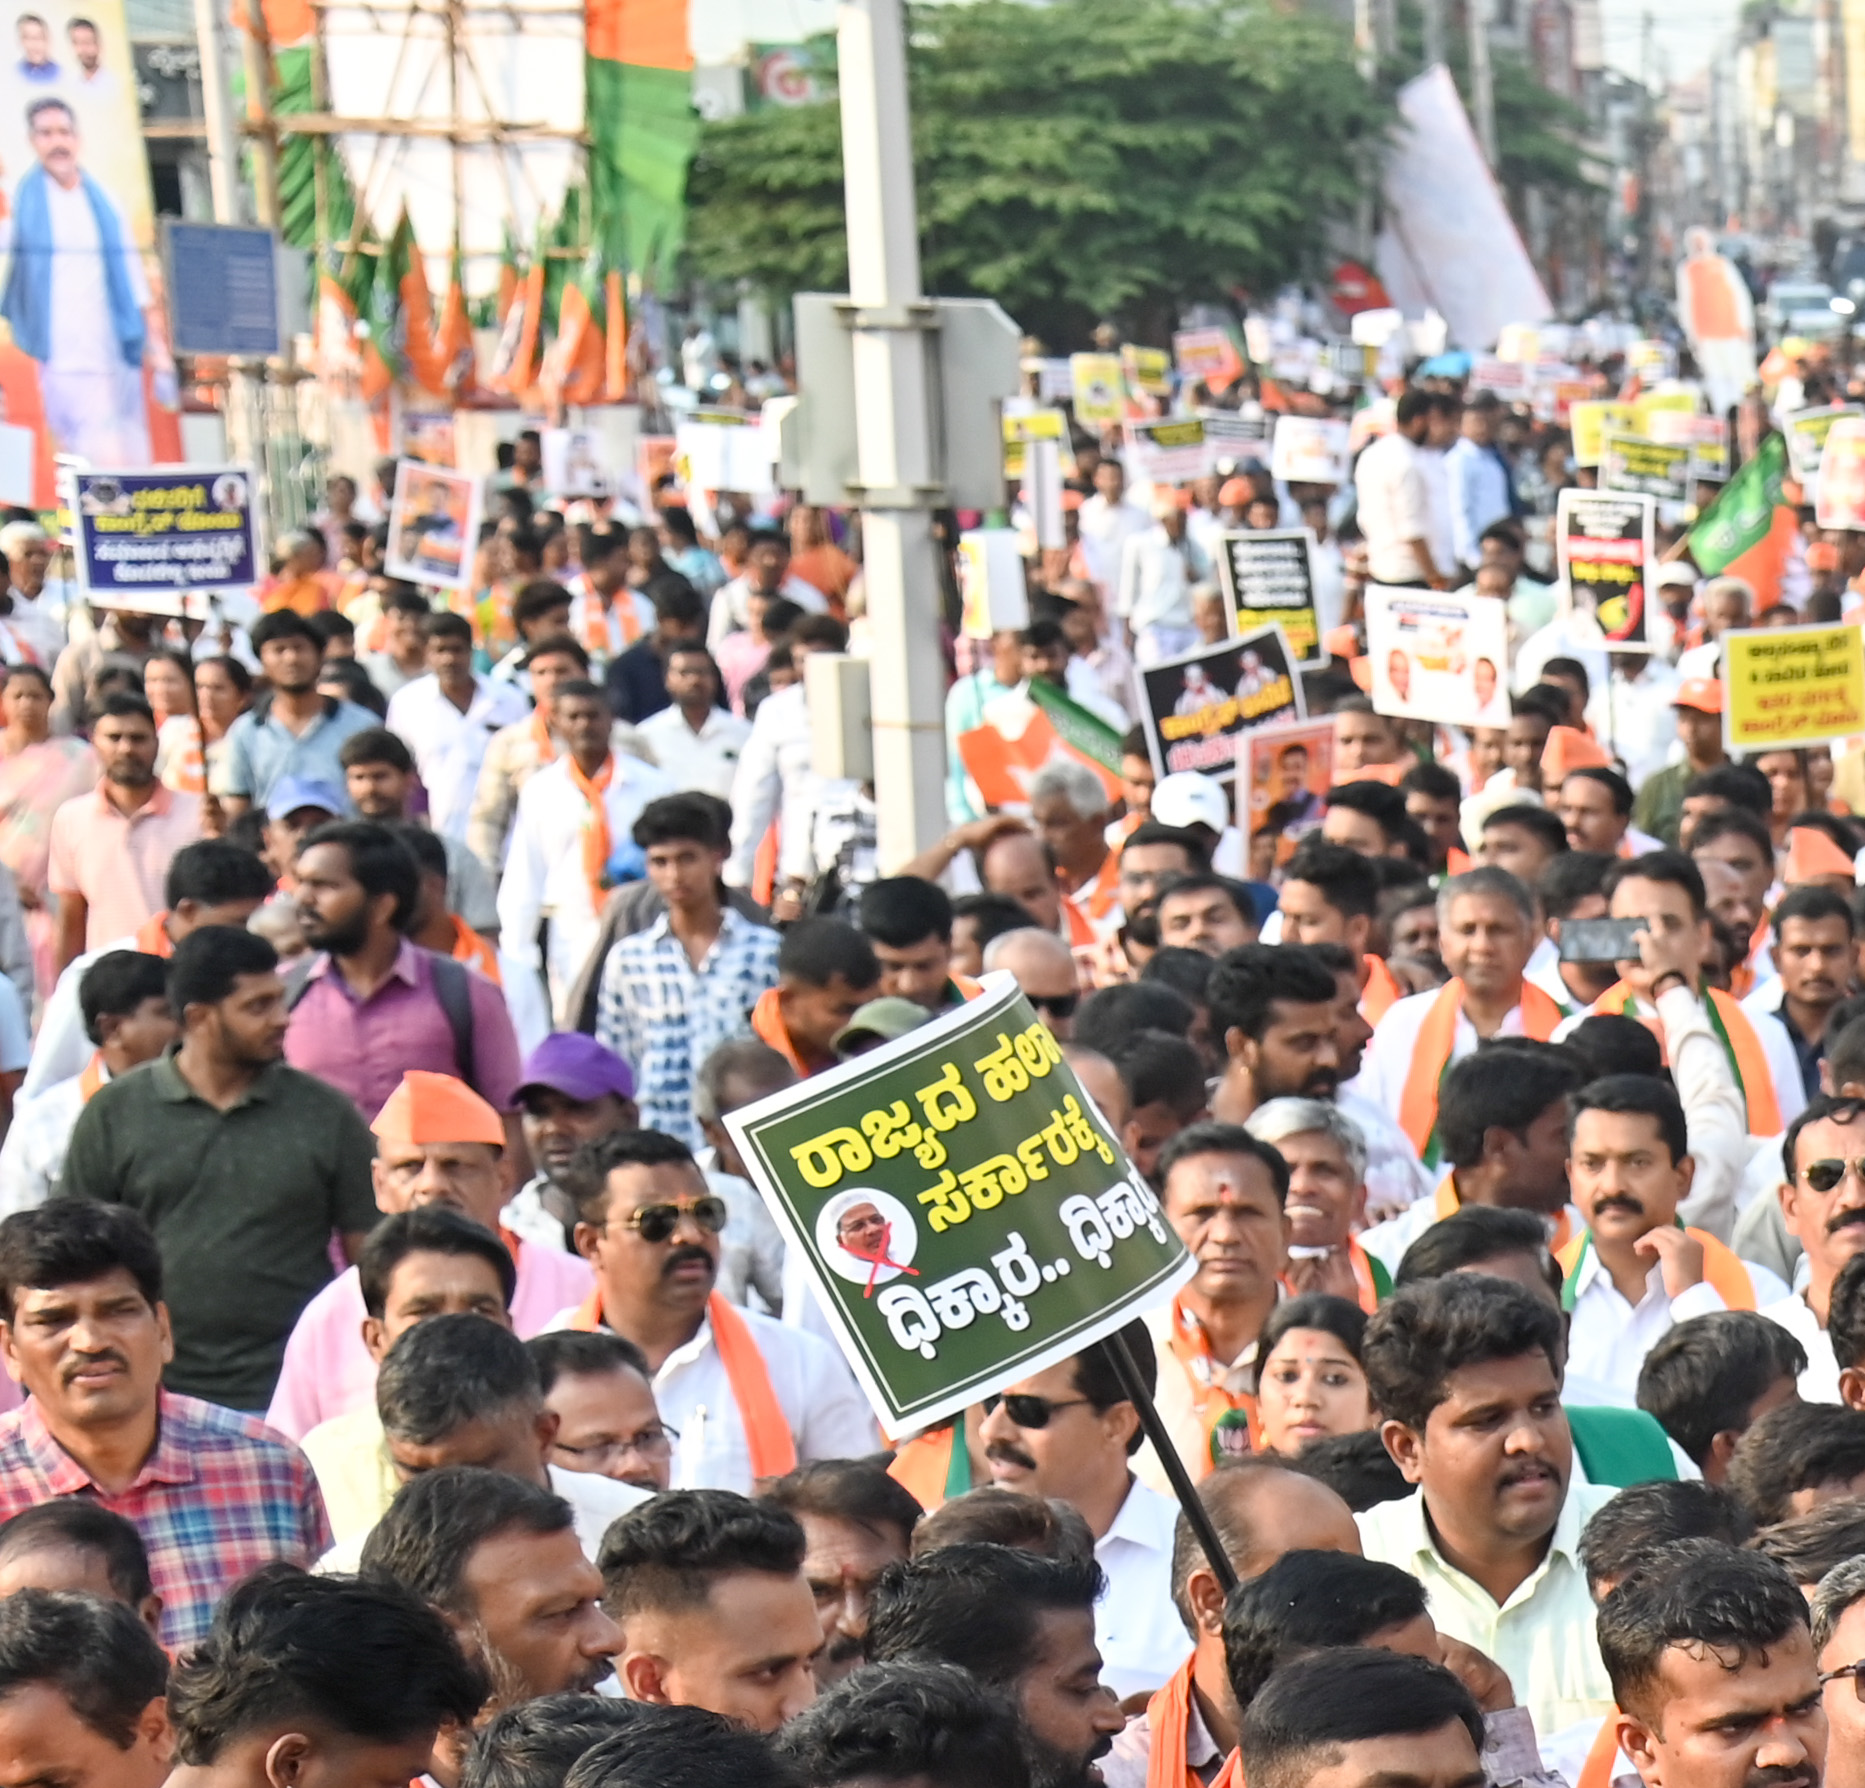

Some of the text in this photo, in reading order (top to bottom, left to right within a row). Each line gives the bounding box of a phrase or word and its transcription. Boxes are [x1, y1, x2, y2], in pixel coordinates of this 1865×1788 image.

[789, 1019, 1062, 1188] ರಾಜ್ಯದ ಹಲಾ
[916, 1094, 1114, 1233] ಸರ್ಕಾರಕ್ಕೆ
[877, 1231, 1070, 1360] ಧಿಕ್ಕಾರ..
